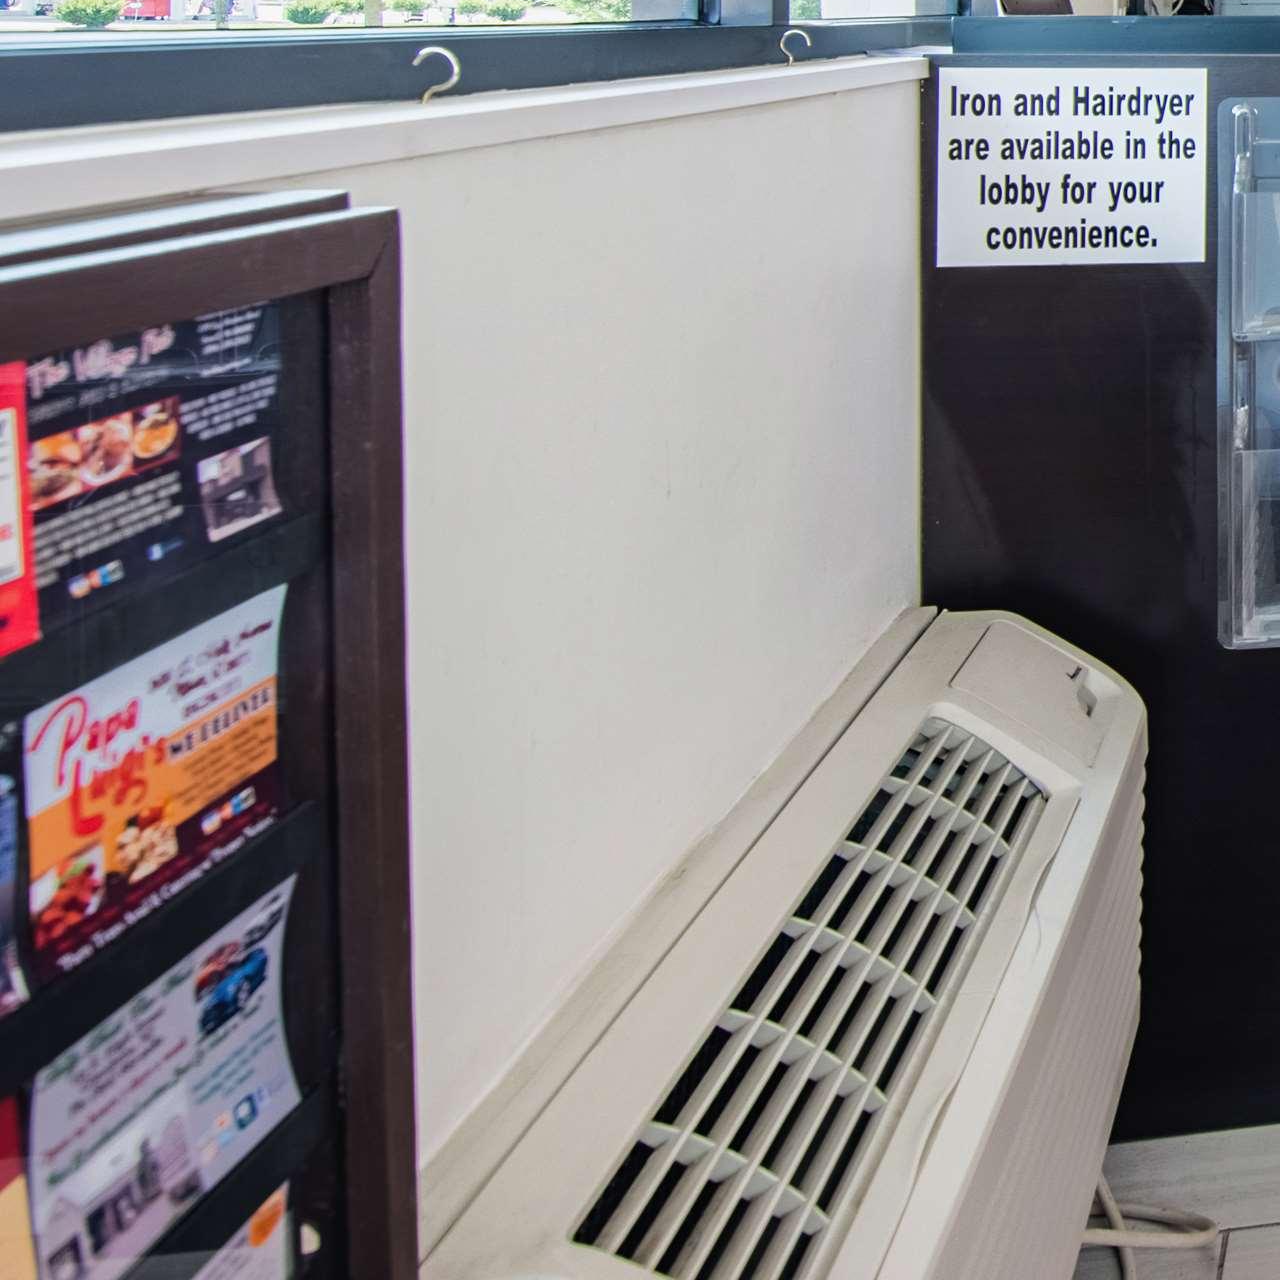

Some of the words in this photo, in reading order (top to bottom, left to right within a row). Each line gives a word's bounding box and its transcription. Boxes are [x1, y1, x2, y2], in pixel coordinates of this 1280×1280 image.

[951, 85, 1001, 117] Iron
[1014, 86, 1060, 117] and
[1072, 85, 1195, 124] Hairdryer
[949, 136, 990, 160] are
[1000, 130, 1114, 160] available
[1125, 131, 1146, 159] in
[1158, 131, 1196, 159] the
[979, 174, 1050, 213] lobby
[1061, 174, 1097, 205] for
[1109, 180, 1165, 212] your
[986, 218, 1158, 250] convenience.
[28, 694, 141, 787] Papa
